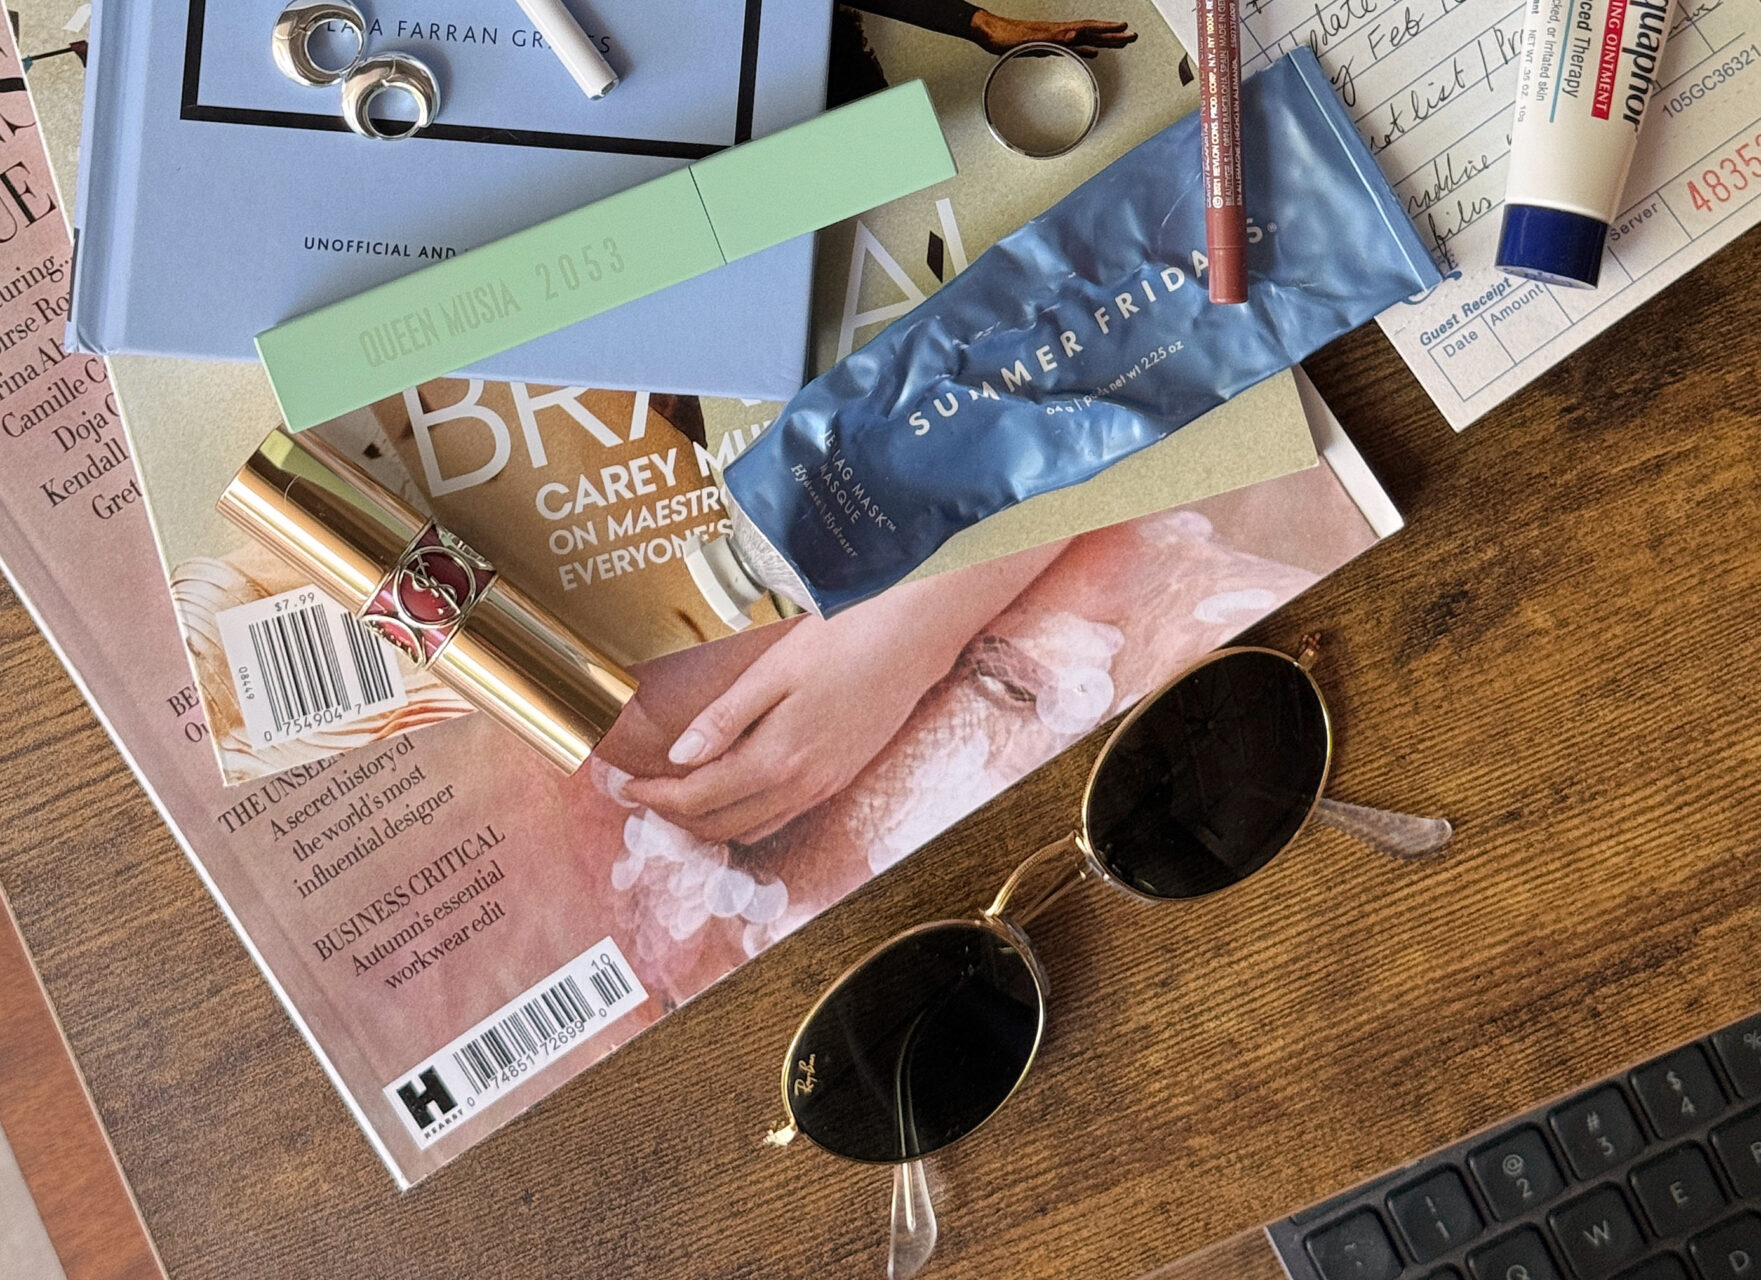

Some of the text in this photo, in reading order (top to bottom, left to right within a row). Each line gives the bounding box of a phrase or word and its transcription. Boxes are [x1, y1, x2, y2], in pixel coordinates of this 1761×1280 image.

[397, 20, 498, 45] FARRAN
[1217, 24, 1227, 46] MADE
[1368, 7, 1424, 60] Feb
[1528, 29, 1537, 44] NET
[1546, 25, 1556, 37] or
[1526, 46, 1535, 62] WT
[1539, 39, 1555, 78] irritated
[1562, 36, 1591, 98] Therapy
[1594, 33, 1618, 112] OINTMENT
[1536, 79, 1549, 101] skin
[1213, 145, 1221, 176] REVLON
[1687, 133, 1761, 212] 4835
[1609, 202, 1660, 241] Server
[304, 237, 456, 260] UNOFFICIAL AND
[1094, 218, 1264, 335] FRIDAS
[358, 236, 625, 368] QUEEN MUSIA 2053
[1419, 277, 1512, 347] Guest Receipt
[1489, 283, 1545, 327] Amount
[1168, 340, 1185, 357] oz
[1443, 330, 1478, 358] Date
[2, 377, 88, 439] Camille
[52, 411, 110, 454] Doja
[40, 437, 129, 507] Kendall
[536, 447, 677, 520] CAREY
[820, 464, 860, 524] MASQUE
[791, 463, 859, 558] Hydrate Hydrater
[549, 521, 598, 555] ON
[275, 592, 315, 612] $7.99
[238, 666, 255, 700] 08449
[264, 703, 362, 742] 0 754904 7
[270, 734, 416, 841] A secret history of
[218, 790, 267, 834] THE
[293, 762, 427, 863] the world's most
[293, 784, 456, 899] influential designer
[313, 825, 506, 962] BUSINESS CRITICAL
[350, 862, 506, 977] Autumn's essential
[384, 900, 506, 990] workwear edit
[591, 953, 611, 971] 10
[466, 1095, 475, 1108] 0
[489, 1053, 536, 1090] 74851
[539, 1021, 586, 1057] 72699
[397, 1066, 458, 1130] H
[423, 1108, 464, 1140] HEARST
